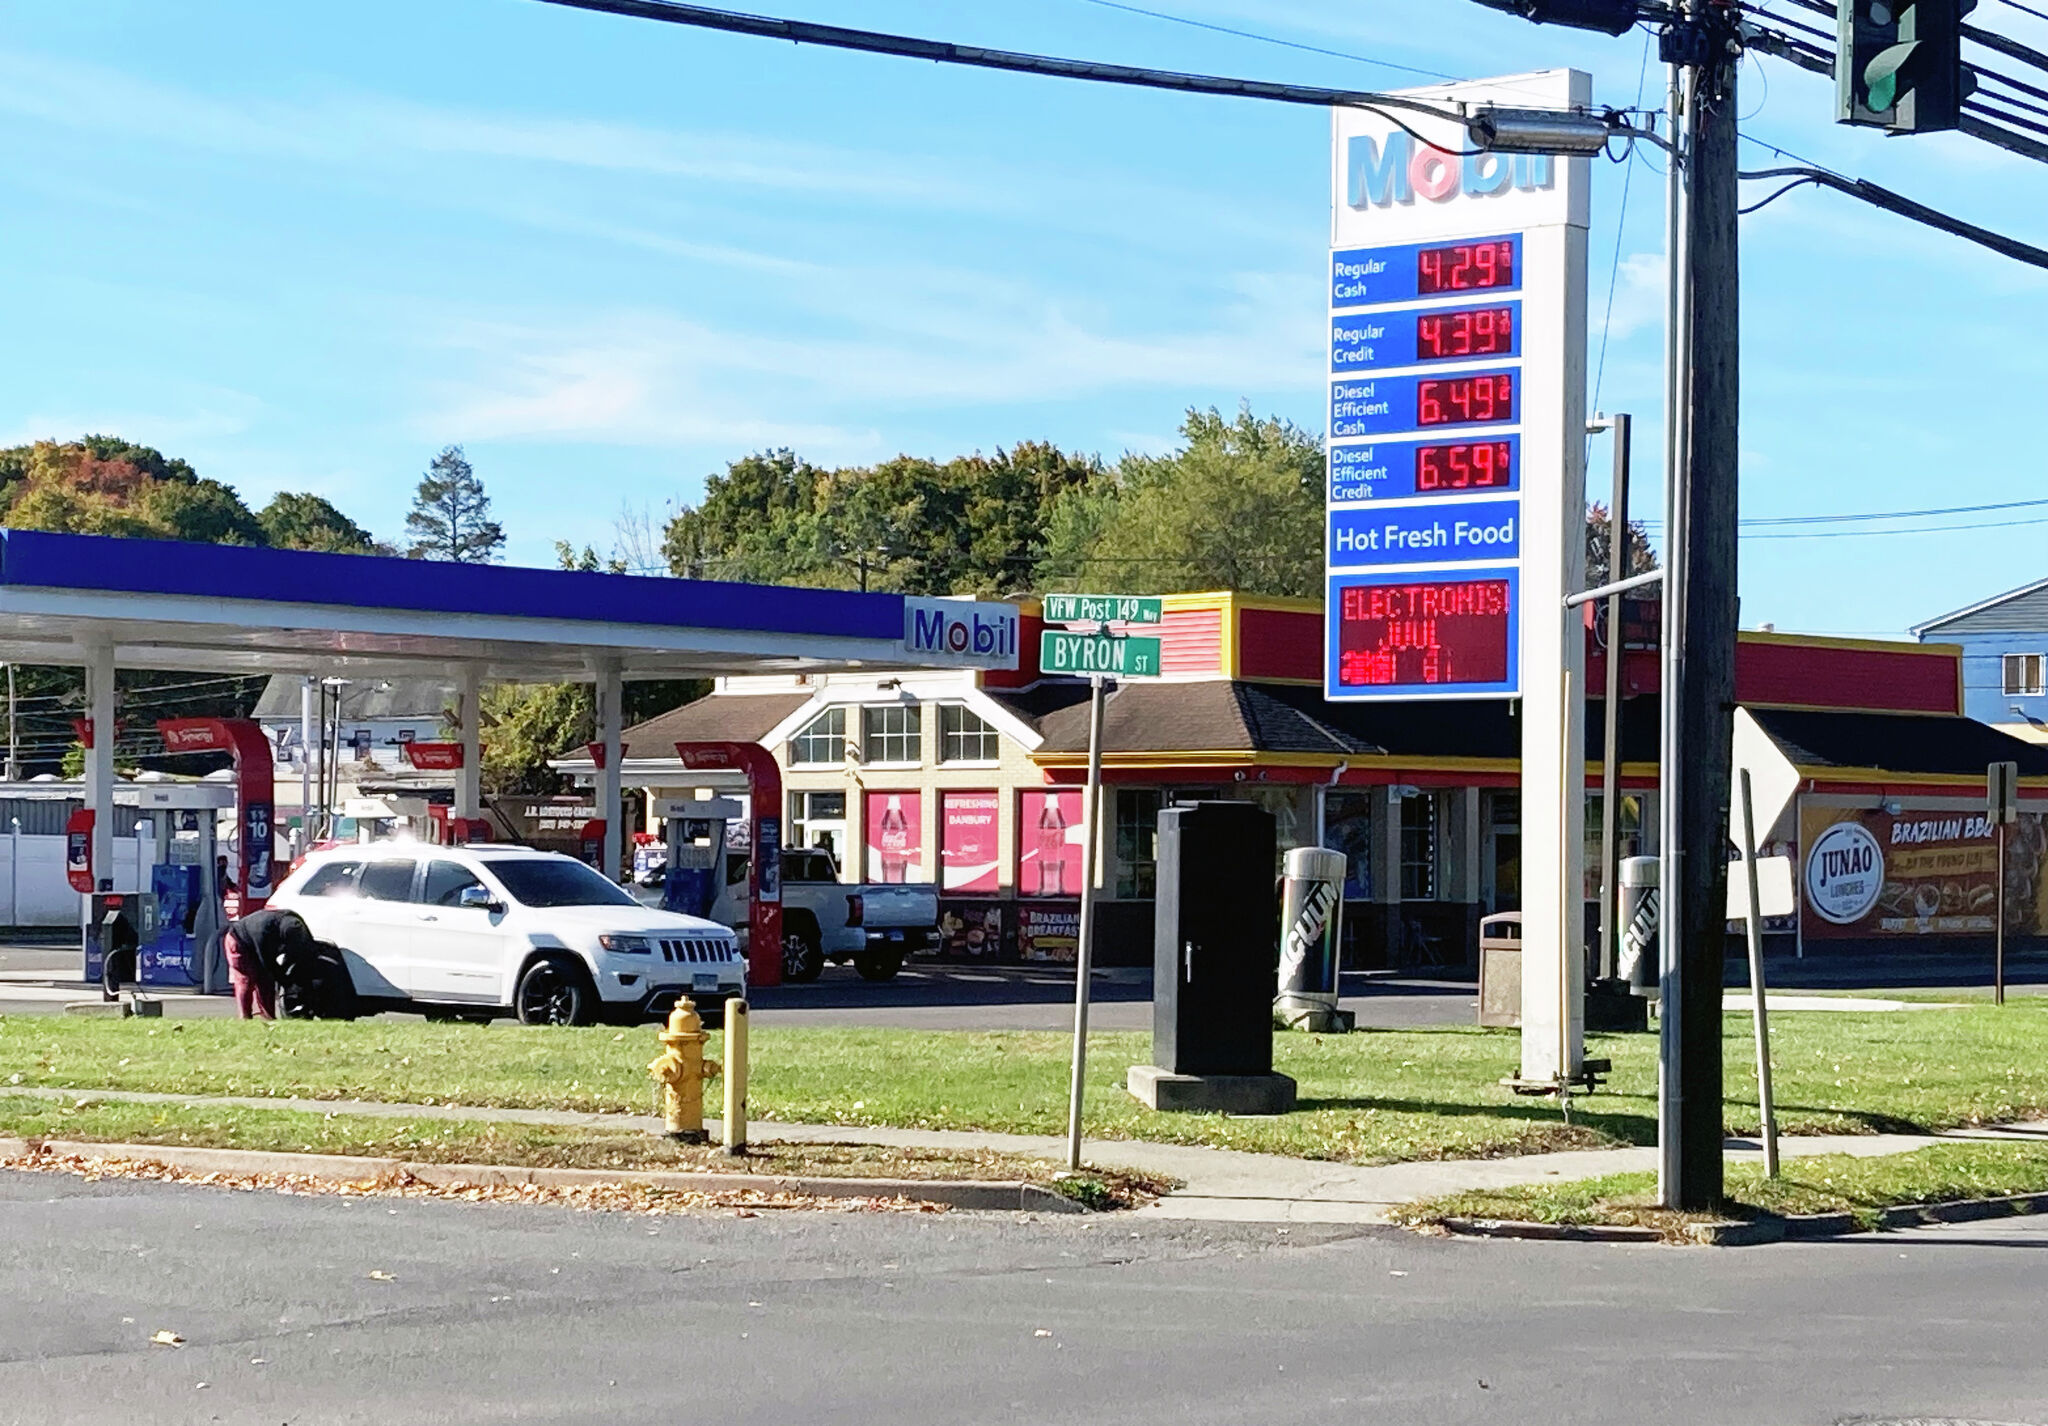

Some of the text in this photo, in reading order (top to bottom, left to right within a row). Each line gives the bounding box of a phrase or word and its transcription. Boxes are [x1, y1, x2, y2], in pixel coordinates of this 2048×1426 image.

[1335, 258, 1387, 280] Regular
[1334, 281, 1367, 298] Cash
[1333, 324, 1385, 345] Regular
[1333, 346, 1374, 363] Credit
[1334, 382, 1374, 400] Diesel
[1334, 401, 1389, 418] Efficient
[1421, 378, 1494, 424] 6.49
[1334, 419, 1365, 435] Cash
[1333, 447, 1373, 464] Diesel
[1333, 465, 1388, 482] Efficient
[1420, 444, 1494, 490] 6.59
[1332, 483, 1373, 500] Credit
[1336, 517, 1514, 552] Hot Fresh Food
[1049, 597, 1076, 618] VFW
[1081, 598, 1111, 620] Post
[1116, 599, 1139, 620] 149
[915, 609, 1015, 655] Mobil
[1054, 637, 1148, 672] BYRON ST
[948, 814, 992, 825] DANBURY
[1890, 818, 1962, 844] BRAZILIAN
